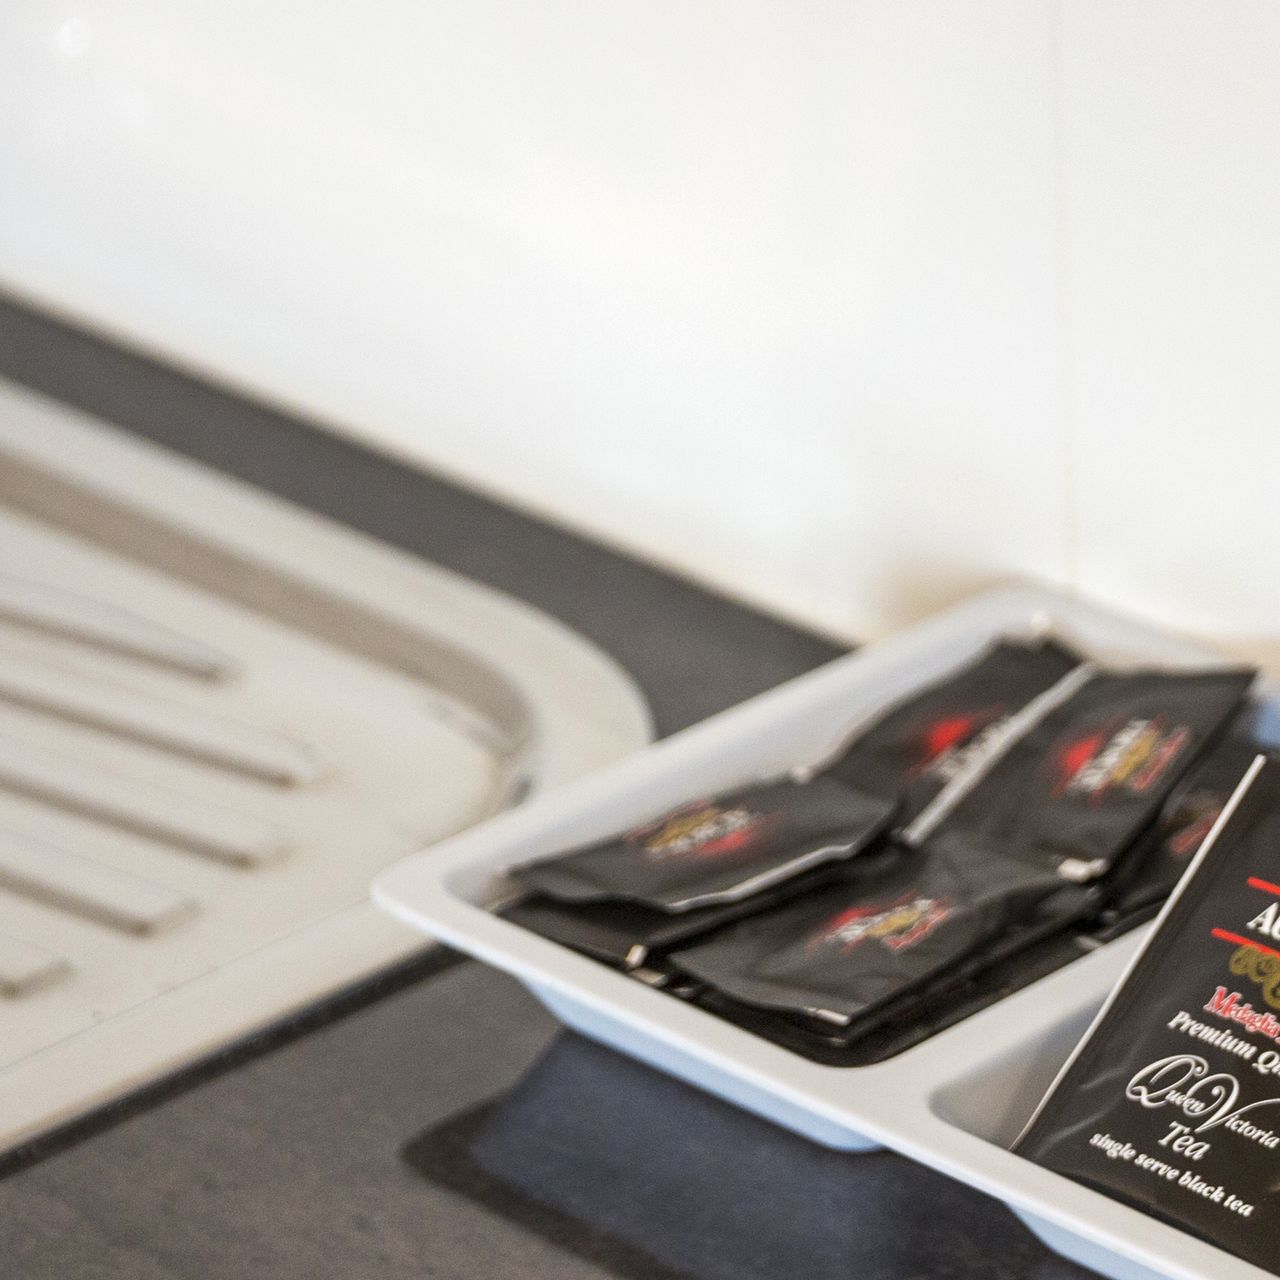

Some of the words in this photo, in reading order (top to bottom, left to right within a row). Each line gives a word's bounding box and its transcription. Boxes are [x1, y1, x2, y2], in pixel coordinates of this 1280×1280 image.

[1167, 1010, 1258, 1060] Premium
[1125, 1054, 1209, 1110] Queen
[1157, 1121, 1210, 1160] Tea
[1089, 1133, 1136, 1160] single
[1134, 1153, 1180, 1180] serve
[1178, 1171, 1225, 1203] black
[1223, 1194, 1255, 1218] tea
